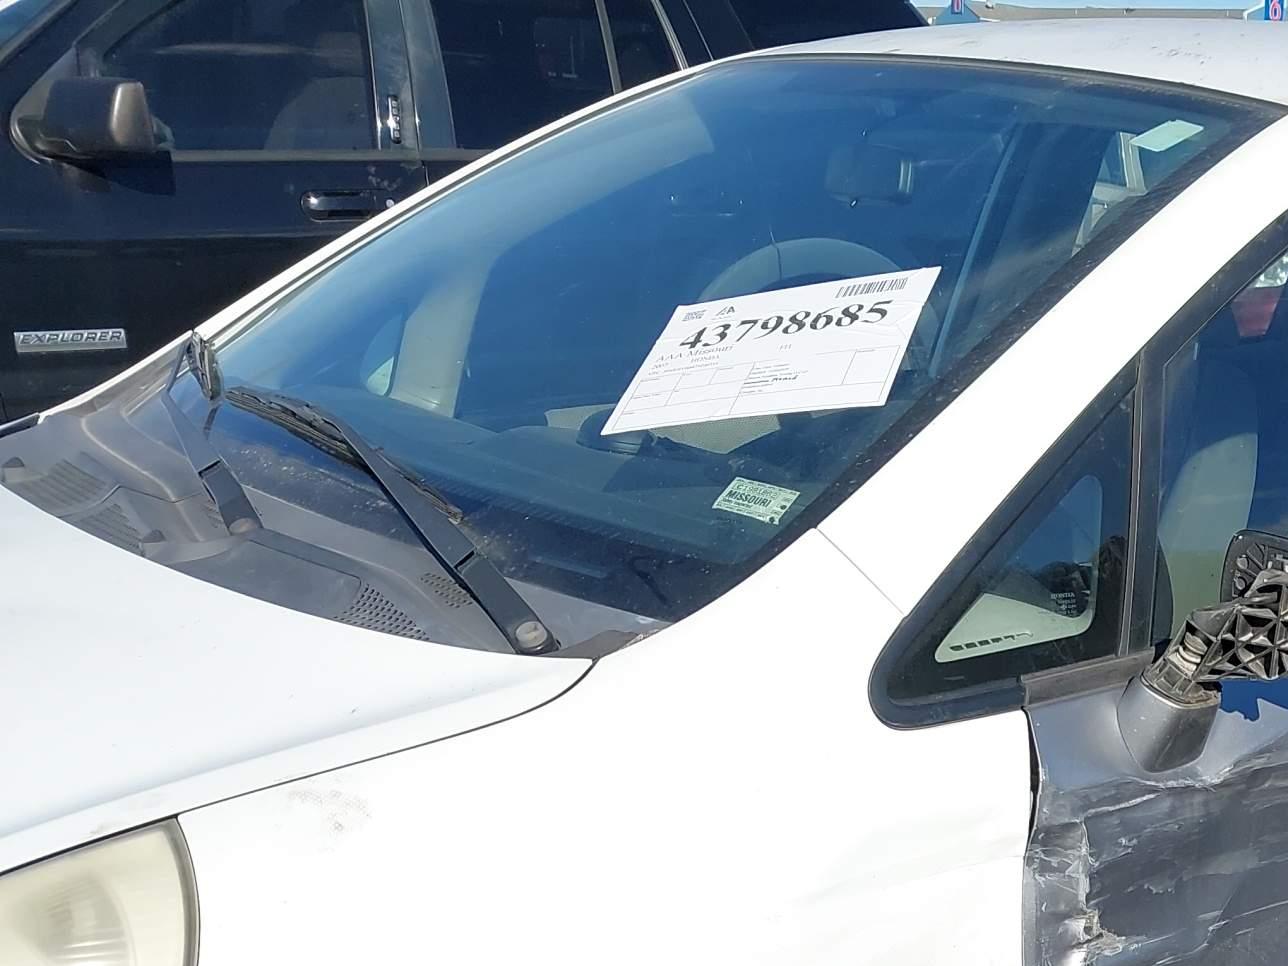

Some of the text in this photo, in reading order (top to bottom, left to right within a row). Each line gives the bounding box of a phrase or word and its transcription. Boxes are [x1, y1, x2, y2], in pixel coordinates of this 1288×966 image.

[679, 300, 893, 349] 43798685
[20, 330, 122, 345] EXPLORER
[725, 489, 772, 508] MISSOURI
